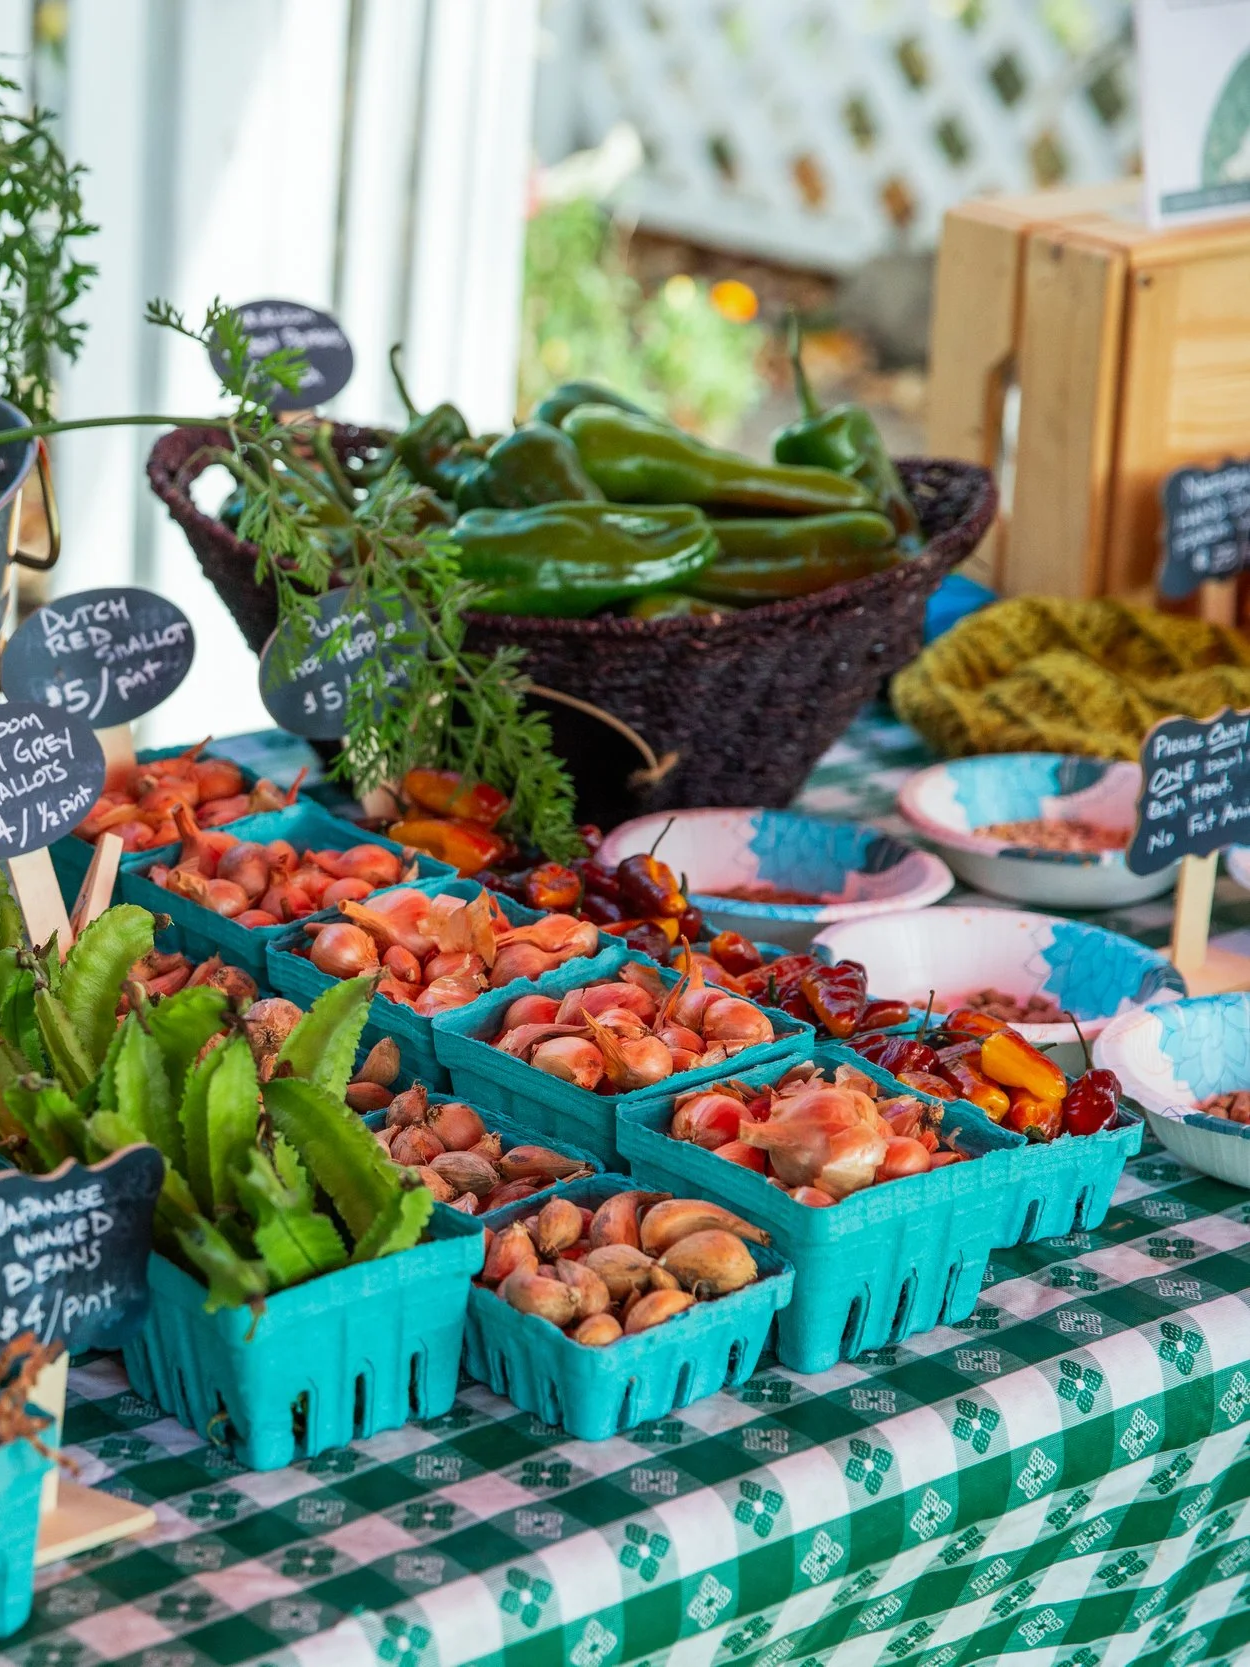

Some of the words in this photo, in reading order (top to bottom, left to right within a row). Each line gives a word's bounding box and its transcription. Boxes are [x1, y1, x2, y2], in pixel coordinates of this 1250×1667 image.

[39, 595, 130, 636] DUTCH
[44, 626, 113, 658] RED
[94, 621, 190, 665] SHALLOT
[12, 727, 75, 764] GREY
[1, 1239, 102, 1297] BEANS
